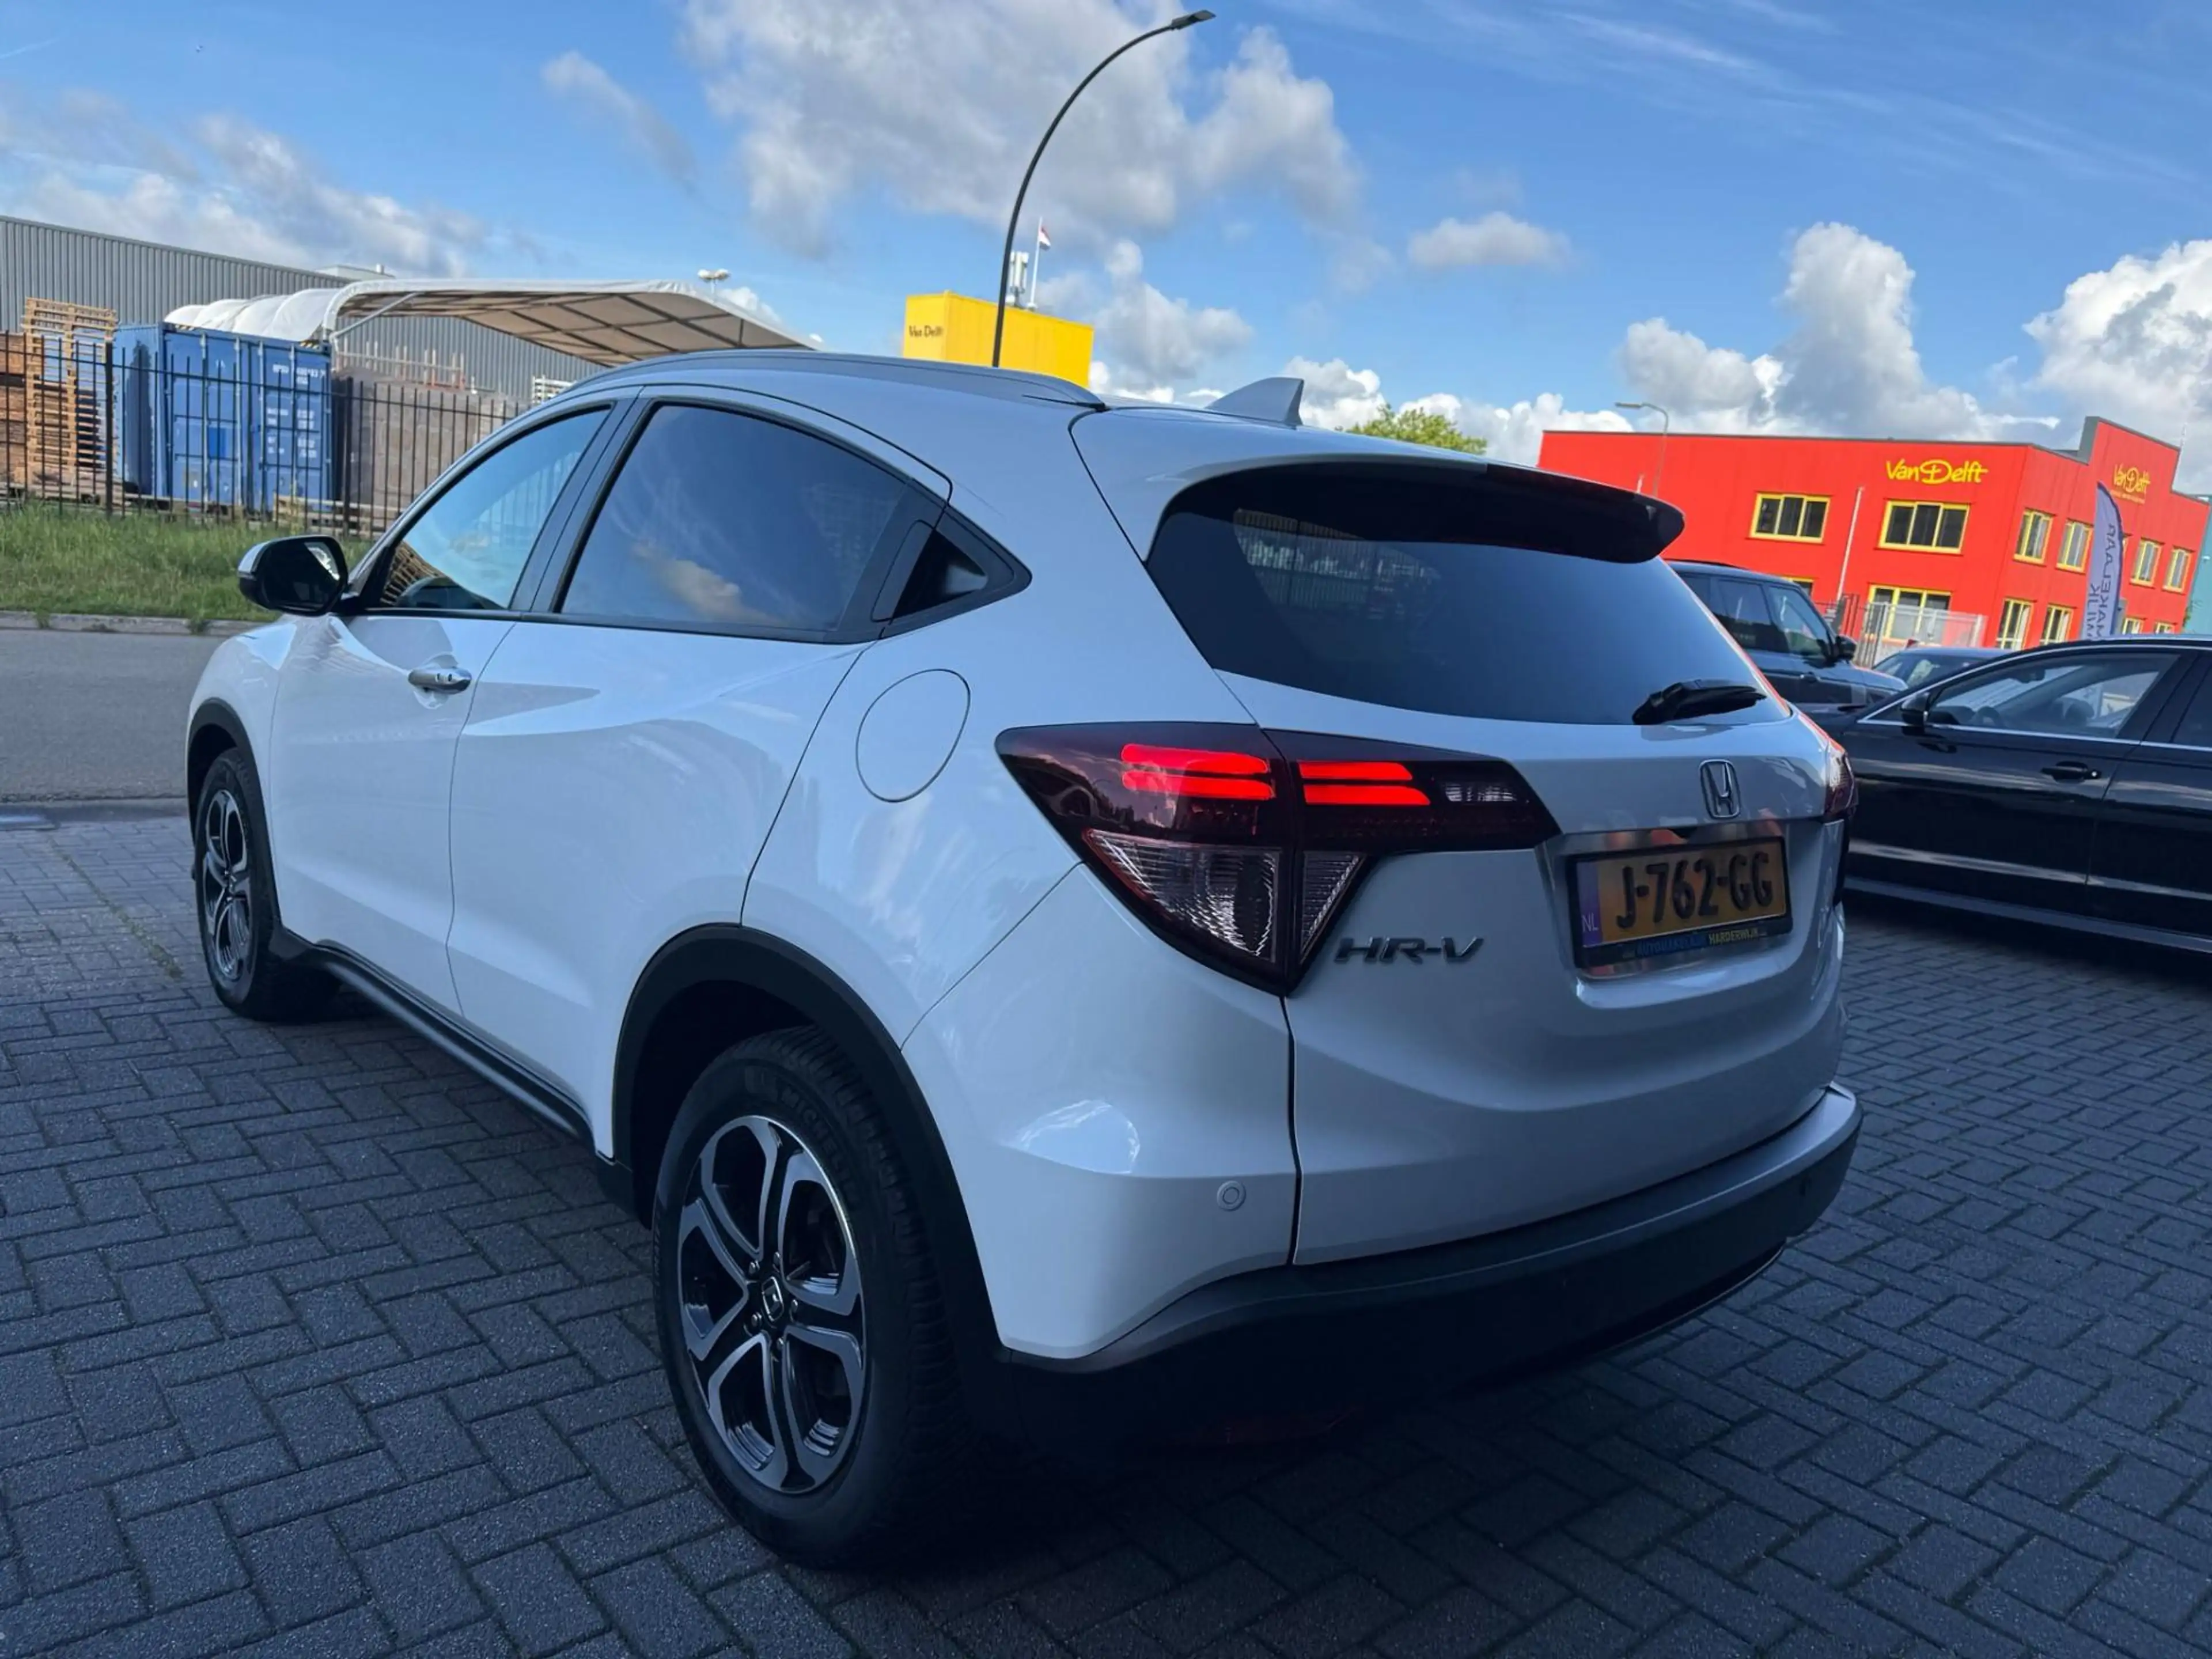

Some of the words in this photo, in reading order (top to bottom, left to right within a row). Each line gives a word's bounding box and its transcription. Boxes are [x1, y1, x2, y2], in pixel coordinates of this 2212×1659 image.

[1616, 851, 1774, 929] J-762-GG
[1582, 912, 1599, 933] NL
[1334, 936, 1484, 964] HR-V
